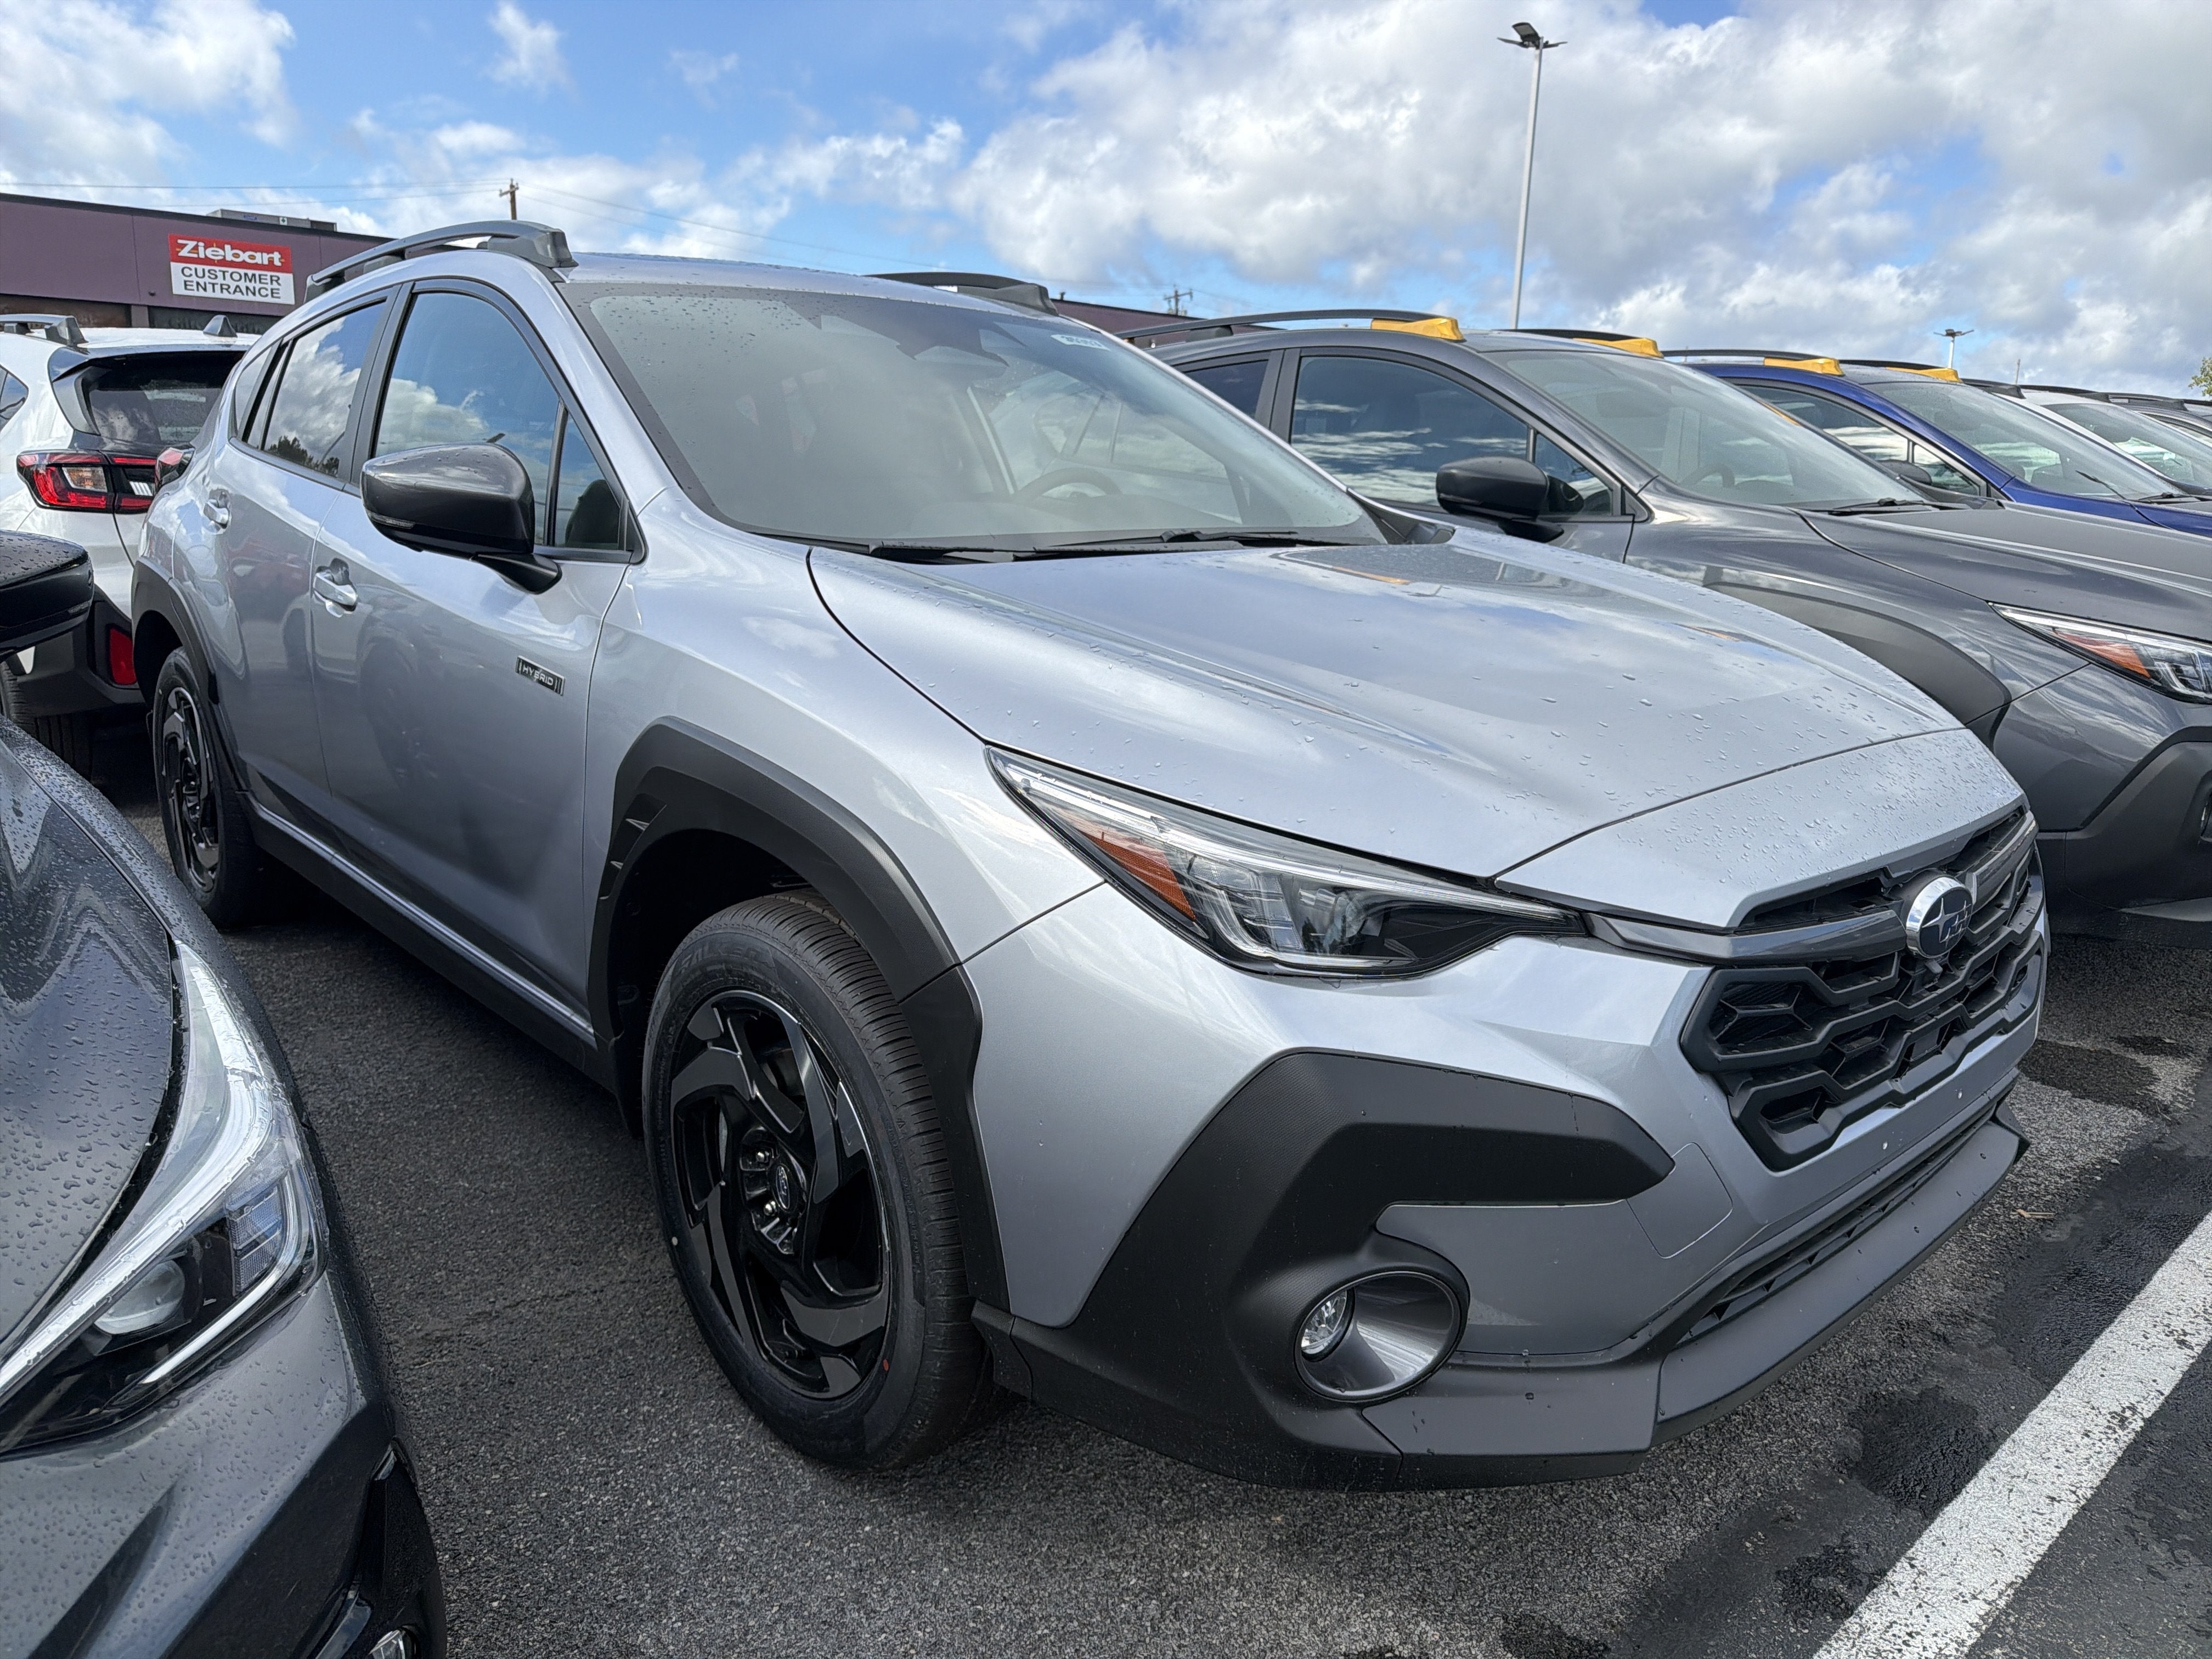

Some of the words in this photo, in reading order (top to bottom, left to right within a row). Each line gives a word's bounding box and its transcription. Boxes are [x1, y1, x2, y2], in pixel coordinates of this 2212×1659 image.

[177, 239, 282, 266] Ziebart
[181, 266, 281, 286] CUSTOMER
[184, 280, 281, 299] ENTRANCE
[523, 664, 554, 686] HYBRID
